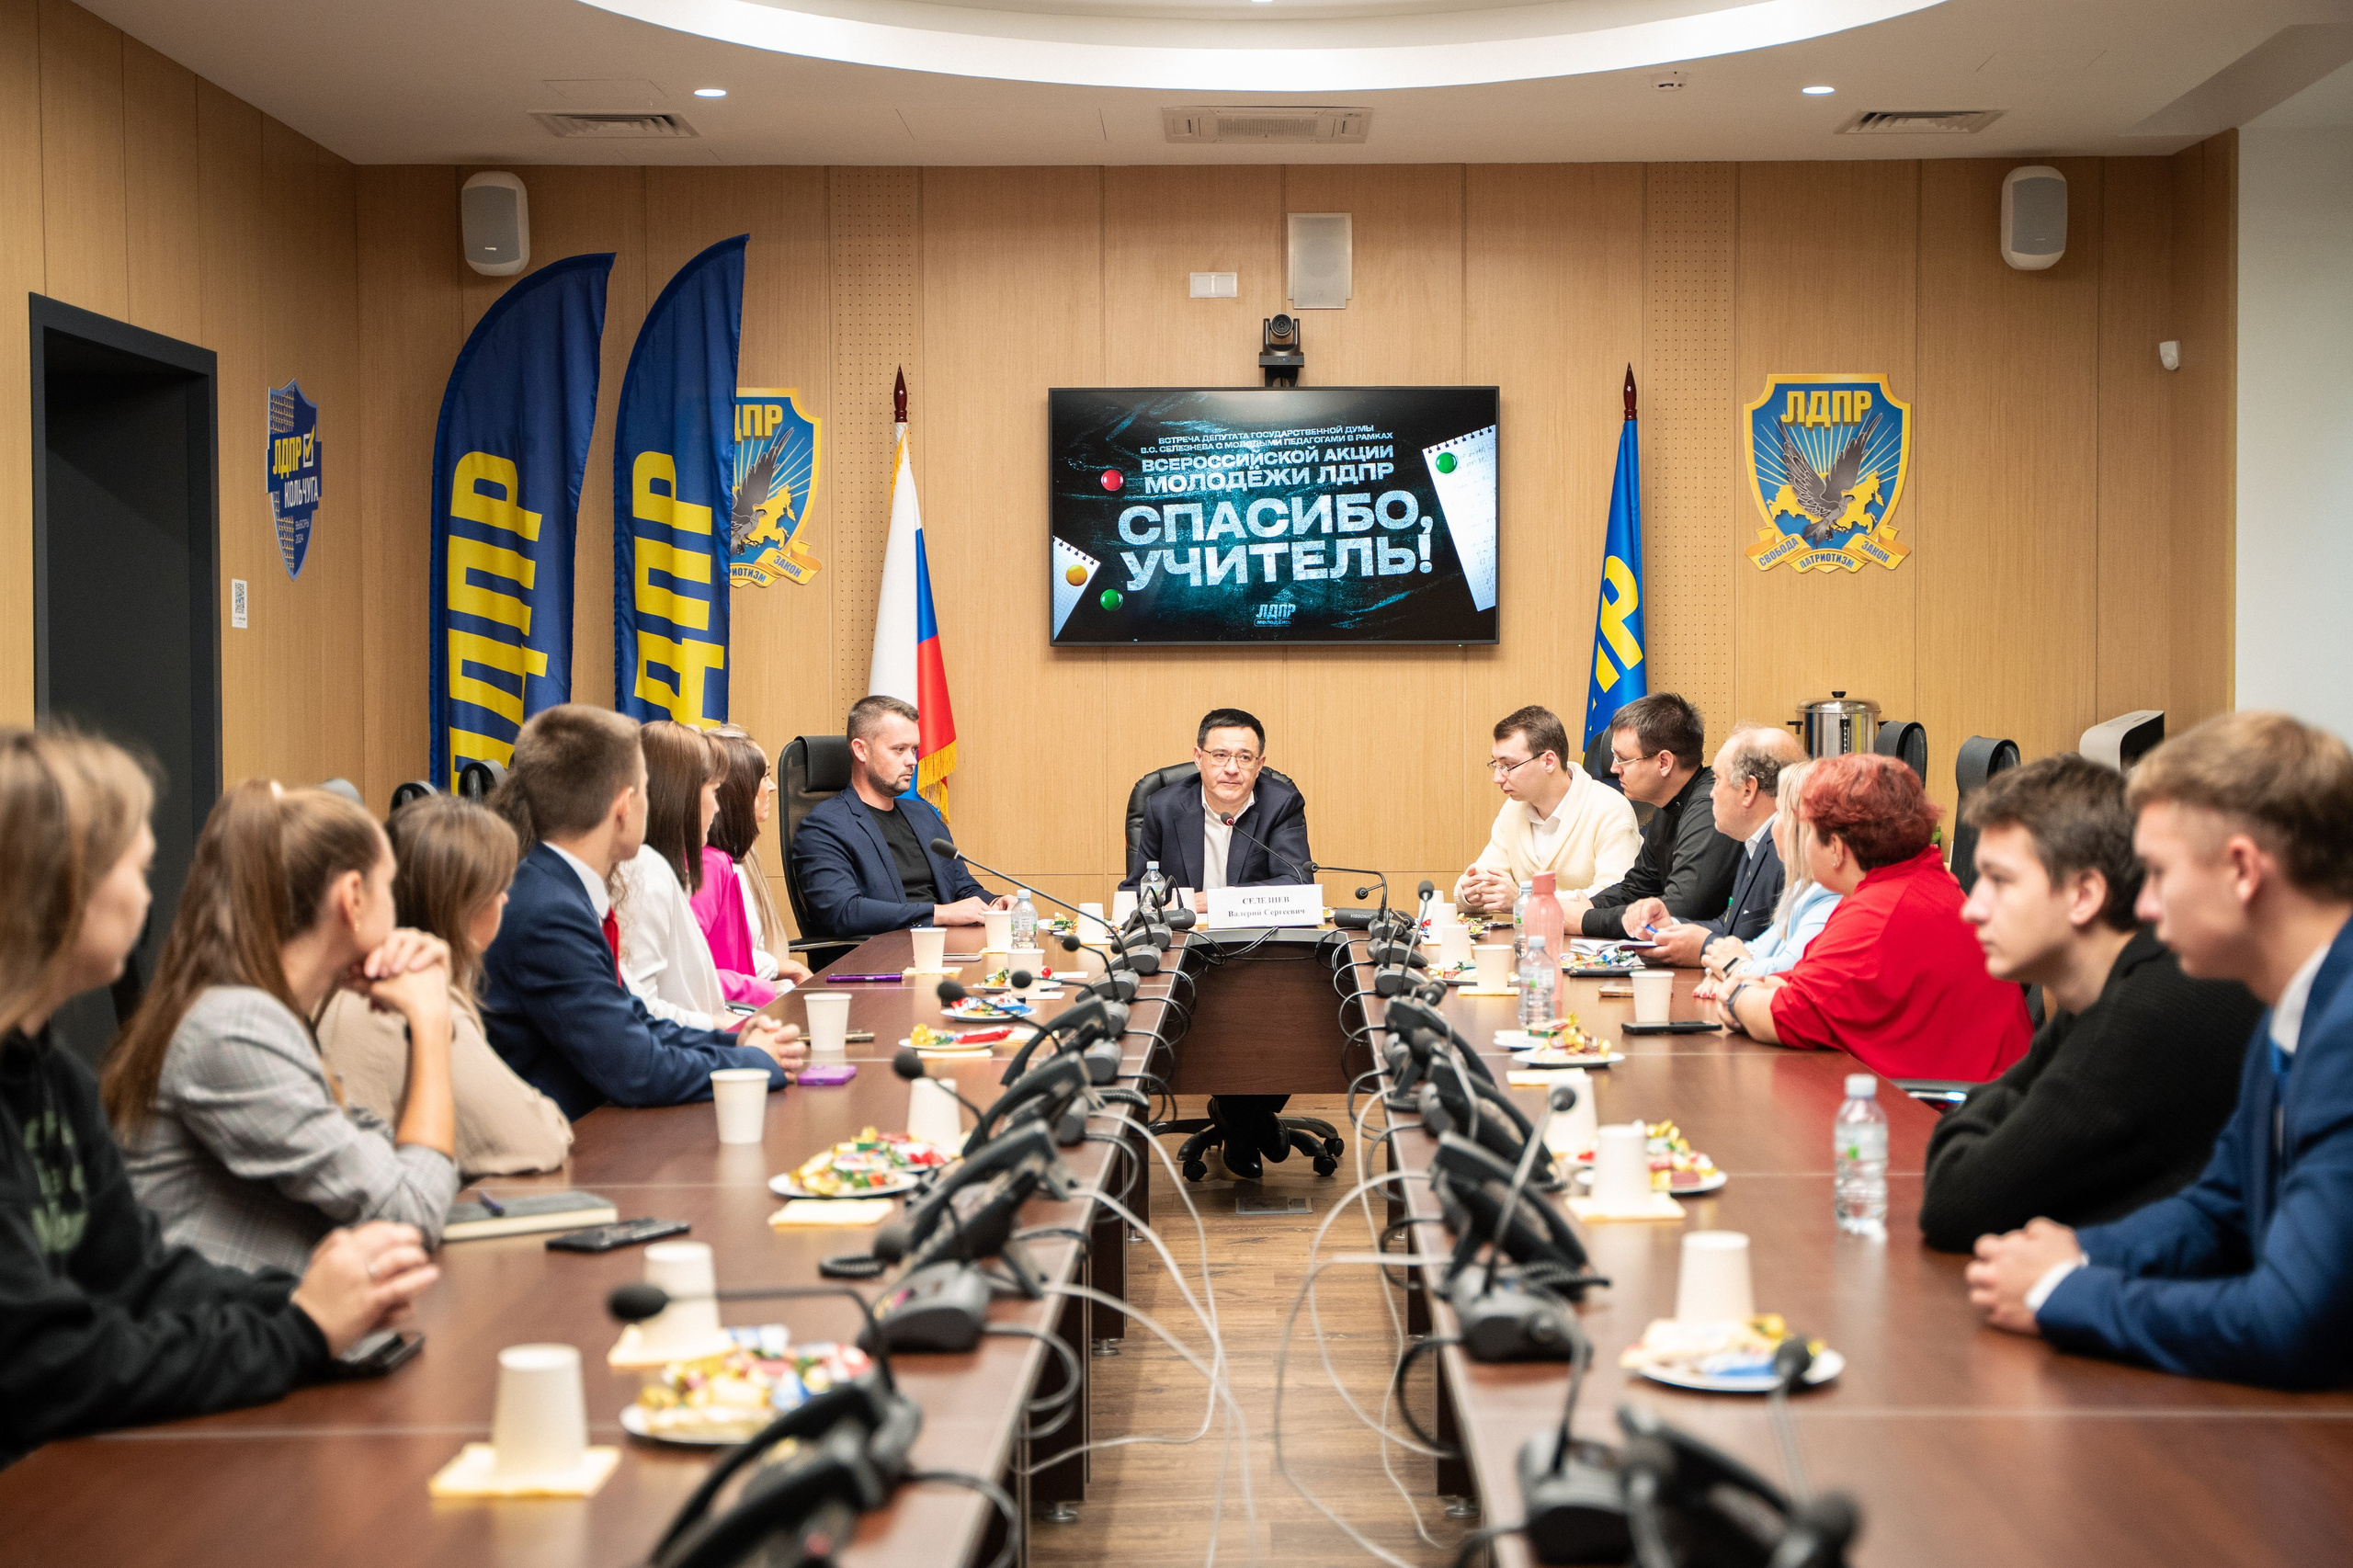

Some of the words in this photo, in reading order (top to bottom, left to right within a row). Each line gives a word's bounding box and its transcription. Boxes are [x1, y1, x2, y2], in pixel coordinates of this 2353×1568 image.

[733, 404, 783, 442] ПР
[1780, 391, 1872, 428] ЛДПР
[1158, 436, 1200, 445] ВСТРЕЧА
[1202, 433, 1250, 443] ДЕПУТАТА
[1251, 425, 1343, 439] ГОСУДАРСТВЕННОЙ
[1345, 425, 1374, 435] ДУМЫ
[1159, 443, 1214, 453] СЕЛЕЗНЕВА
[1224, 438, 1282, 449] МОЛОДЫМИ
[1284, 436, 1346, 447] ПЕДАГОГАМИ
[1347, 434, 1355, 442] В
[1356, 432, 1393, 441] РАМКАХ
[273, 437, 301, 479] ЛДПР
[1142, 446, 1320, 472] ВСЕРОССИЙСКОЙ
[1324, 445, 1394, 462] АКЦИИ
[284, 476, 319, 508] КОЛЬЧУГА
[1144, 465, 1310, 494] МОЛОДЁЖИ
[1316, 462, 1394, 486] ЛДПР
[1118, 490, 1434, 545] СПАСИБО,
[730, 567, 767, 583] ИОТИЗМ
[773, 555, 802, 578] ЗАКОН
[1120, 533, 1434, 591] УЧИТЕЛЬ!
[1758, 537, 1800, 566] СВОБОДА
[1799, 552, 1855, 569] ПАТРИОТИЗМ
[1861, 540, 1891, 563] ЗАКОН
[632, 450, 724, 733] ДПР
[1256, 604, 1296, 619] ЛДПР
[1228, 909, 1262, 917] Валерий
[1264, 908, 1305, 916] Сергеевич
